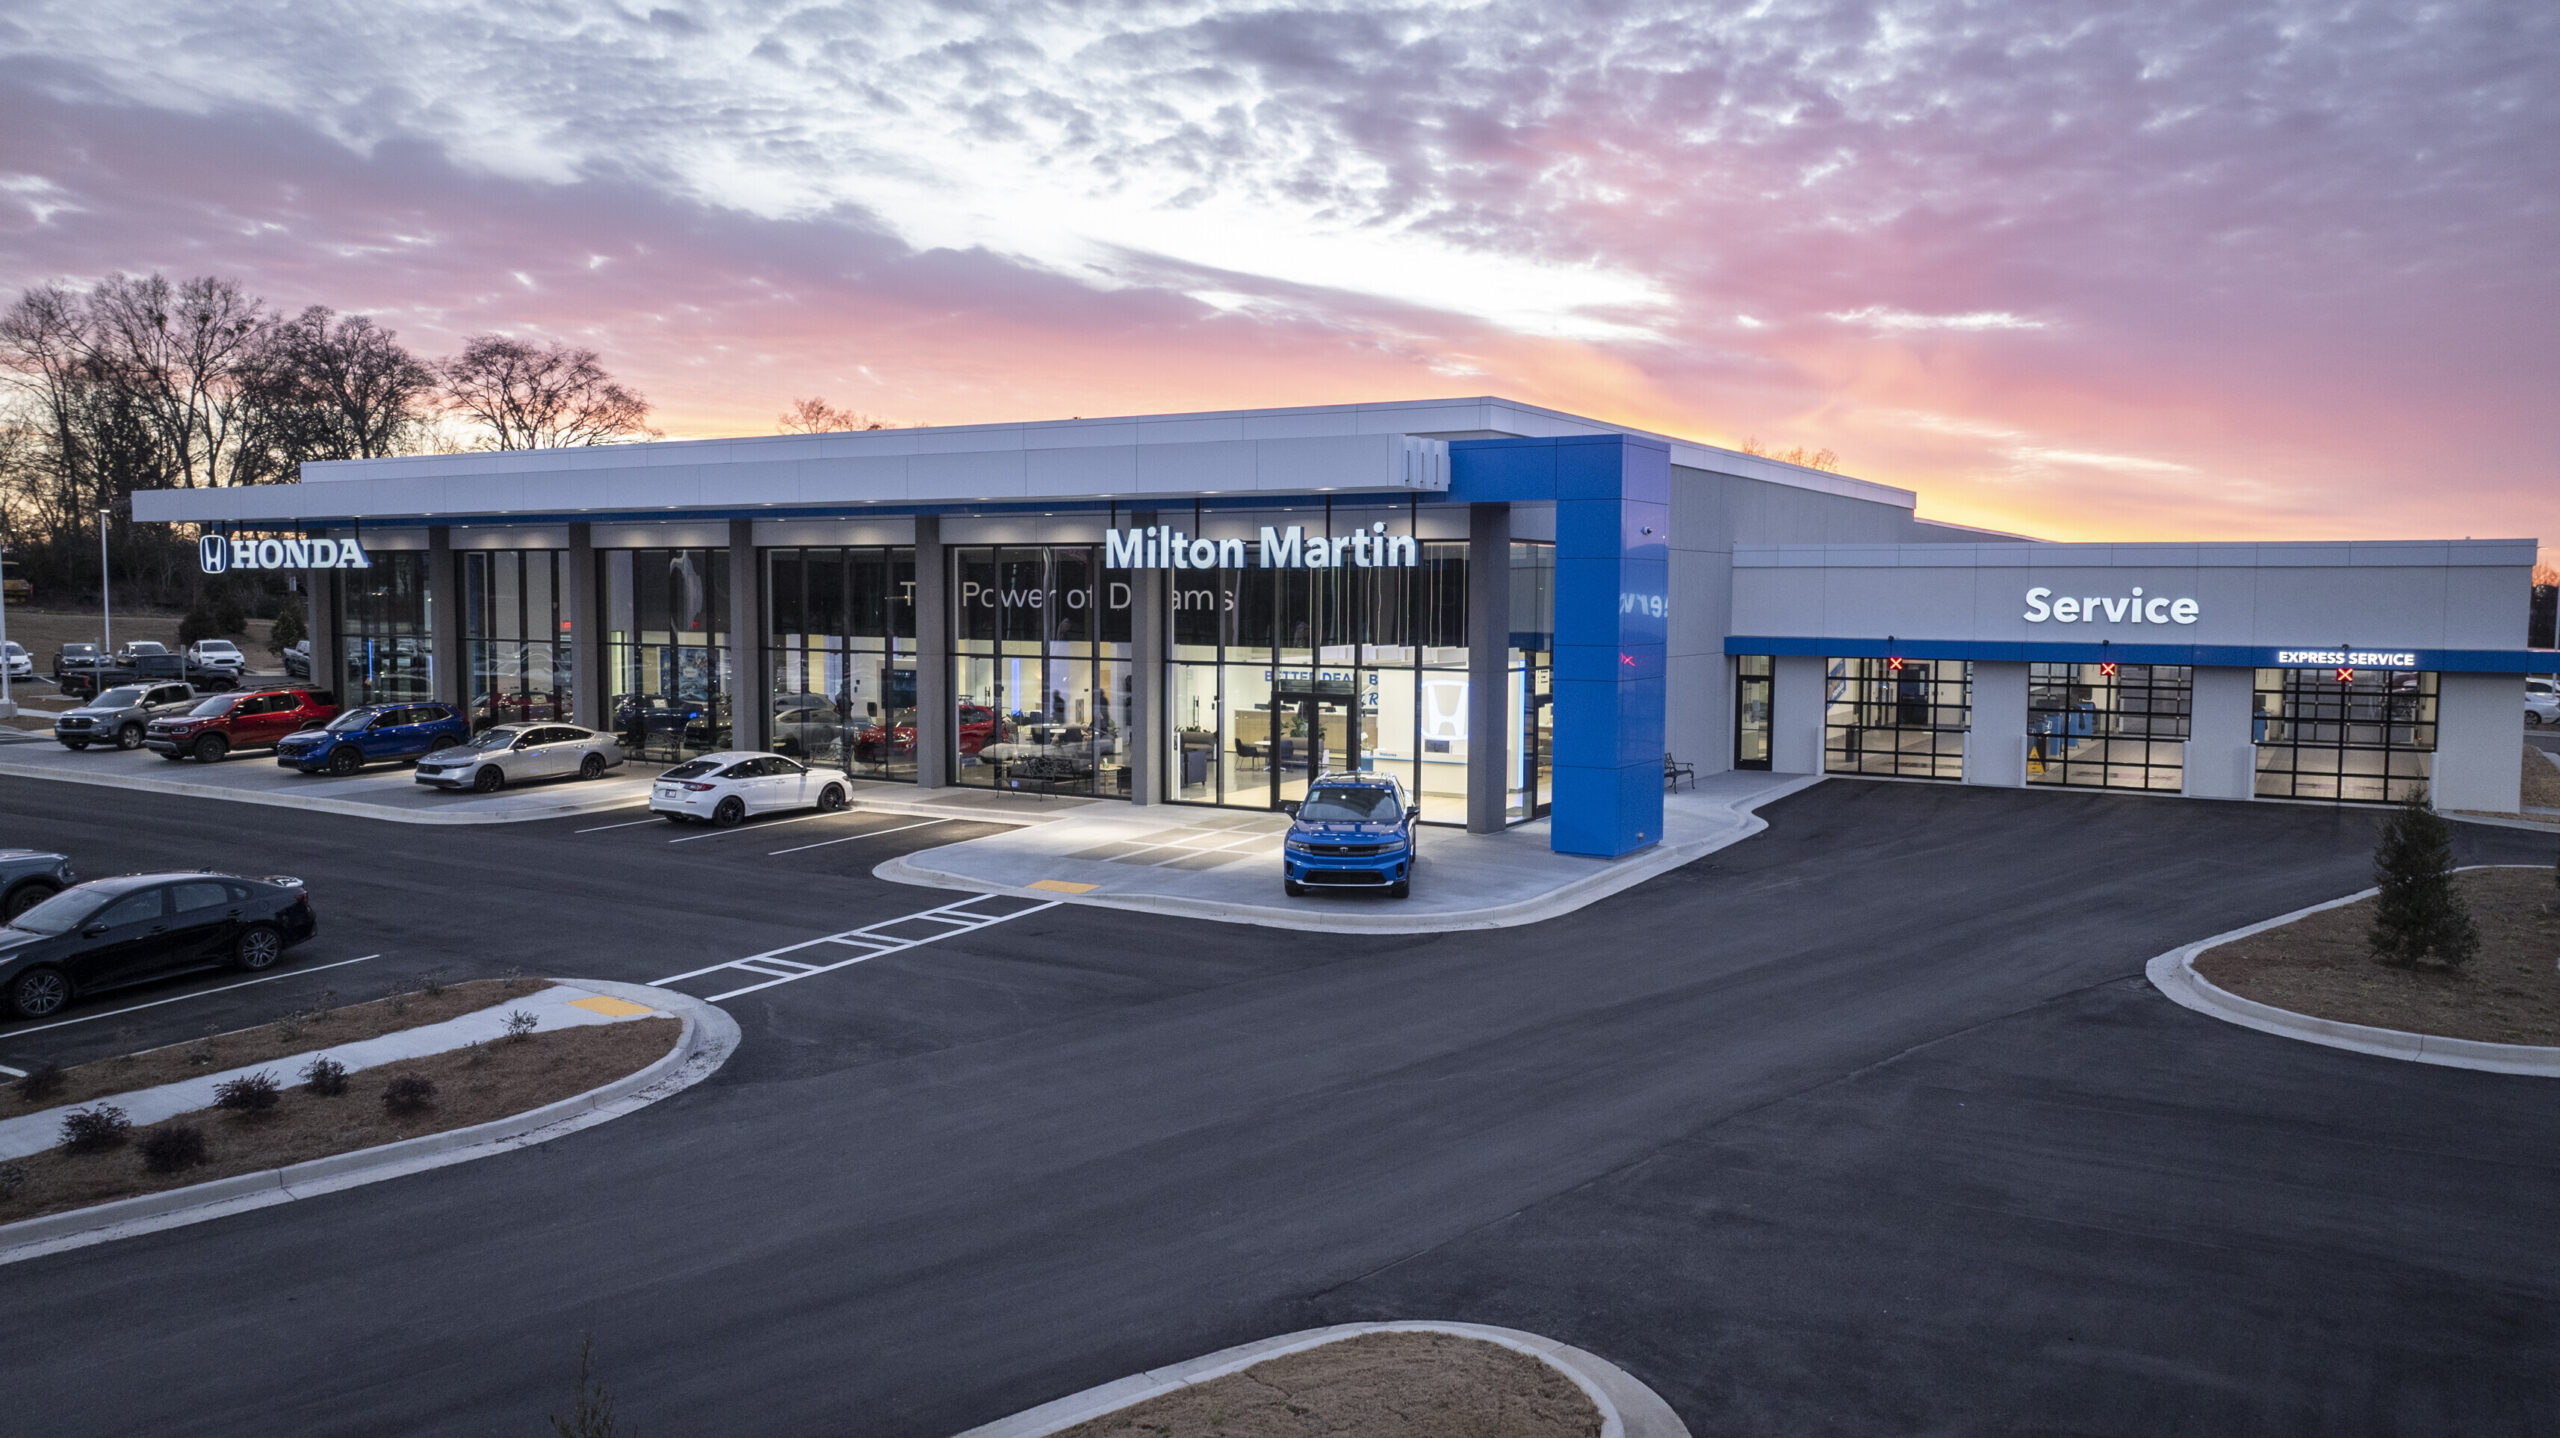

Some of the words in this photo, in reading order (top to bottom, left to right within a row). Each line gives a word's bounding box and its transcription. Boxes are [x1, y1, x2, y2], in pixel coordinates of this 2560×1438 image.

[230, 538, 371, 570] HONDA
[1105, 525, 1247, 569] Milton
[1260, 521, 1418, 568] Martin
[1109, 582, 1234, 611] Dams
[2023, 587, 2200, 625] Service
[2278, 651, 2346, 665] EXPRESS
[2348, 652, 2416, 666] SERVICE
